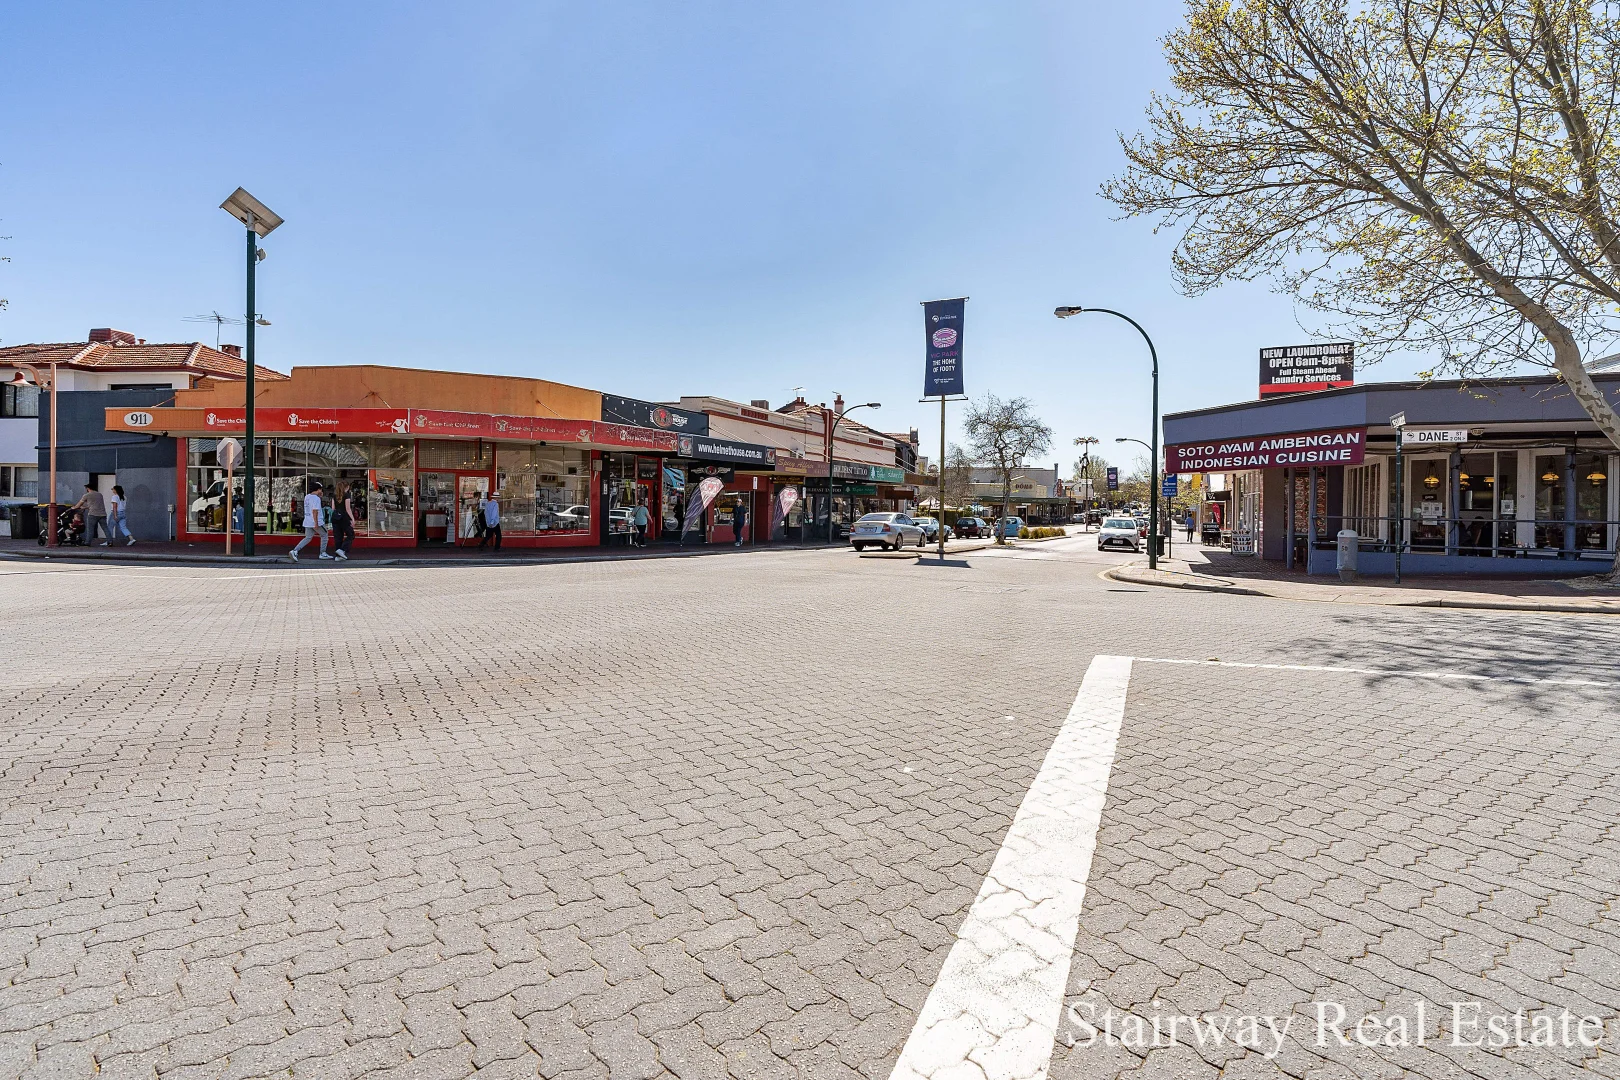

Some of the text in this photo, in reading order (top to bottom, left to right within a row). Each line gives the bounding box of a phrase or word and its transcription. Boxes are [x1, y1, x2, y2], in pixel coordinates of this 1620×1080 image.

[1262, 344, 1350, 358] NEW LAUNDROMAT
[1269, 355, 1345, 368] OPEN 6am-8pm
[1279, 366, 1337, 376] Full Steam Ahead
[1271, 373, 1341, 384] Laundry Services
[130, 413, 148, 425] 911
[1418, 431, 1449, 442] DANE
[697, 443, 763, 459] www.helmethouse.com.au
[1178, 432, 1360, 458] SOTO AYAM AMBENGAN
[1181, 449, 1352, 470] INDONESIAN CUISINE
